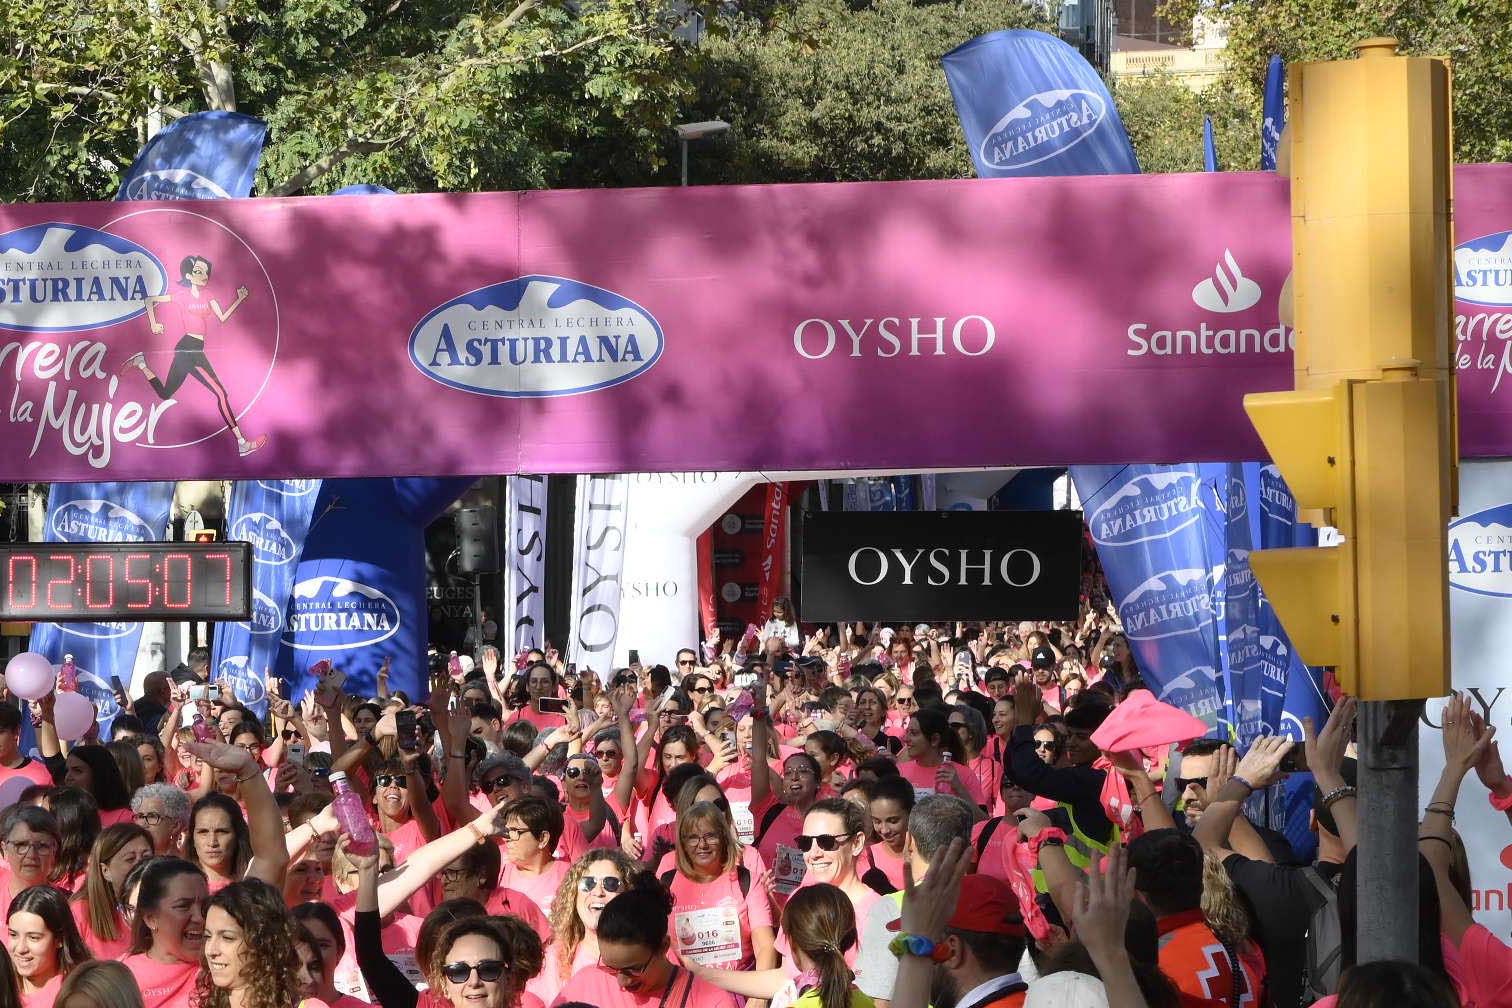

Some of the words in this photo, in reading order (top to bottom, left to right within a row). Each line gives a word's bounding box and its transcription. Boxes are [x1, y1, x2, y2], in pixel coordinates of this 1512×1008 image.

[69, 257, 143, 271] LECHERA
[467, 317, 546, 331] CENTRAL
[555, 315, 636, 329] LECHERA
[793, 315, 996, 360] OYSHO
[1126, 322, 1296, 357] Santand
[1455, 312, 1512, 342] arre
[427, 322, 645, 367] ASTURIANA
[1476, 342, 1495, 369] la
[8, 382, 33, 424] la
[29, 375, 178, 469] Mujer
[8, 553, 231, 610] 02:05:07
[847, 546, 1042, 587] OYSHO
[697, 930, 719, 940] 016
